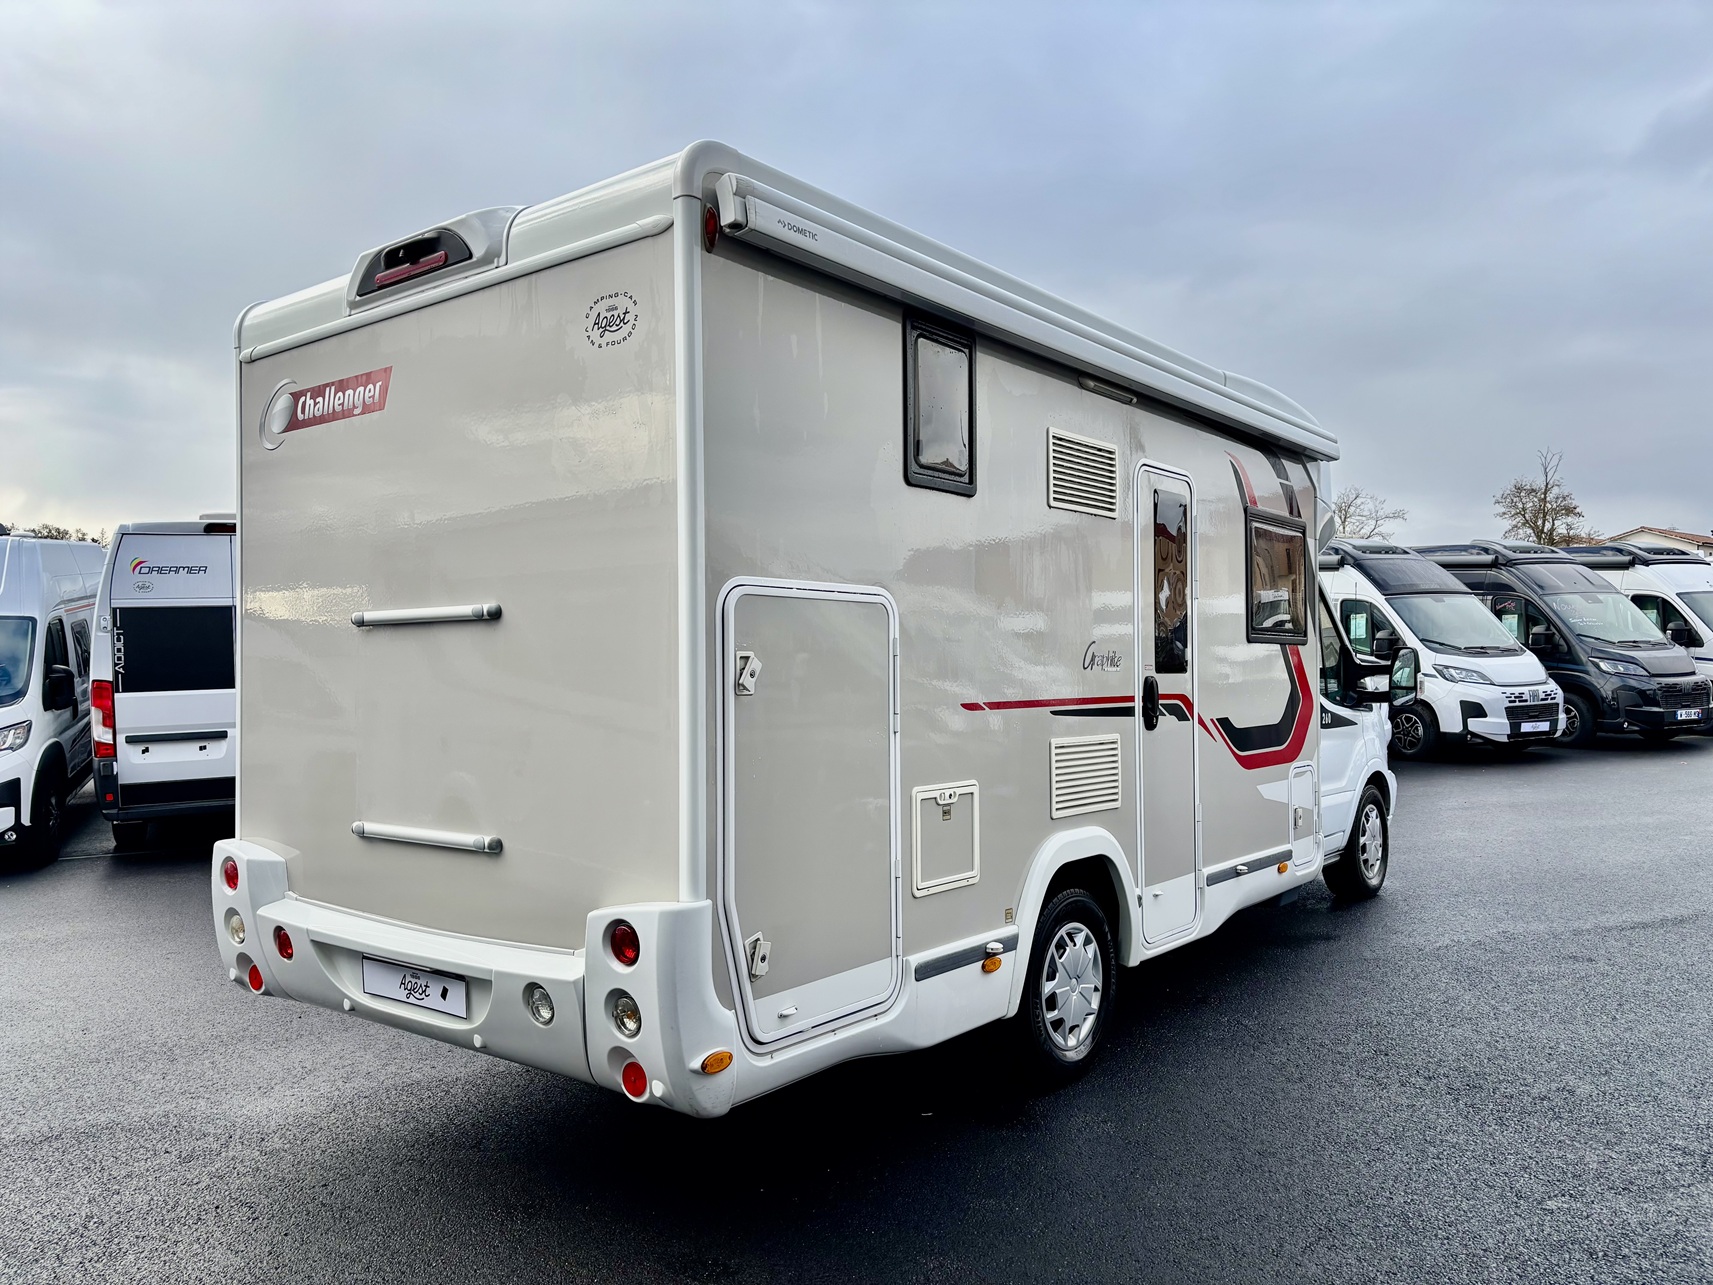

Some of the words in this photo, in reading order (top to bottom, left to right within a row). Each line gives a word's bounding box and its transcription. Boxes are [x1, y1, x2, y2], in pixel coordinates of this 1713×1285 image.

[787, 222, 818, 241] DOMETIC
[585, 291, 638, 319] CAMPING-CAR
[591, 307, 631, 338] Agest
[606, 314, 638, 347] FOURGON
[297, 381, 383, 421] Challenger
[138, 565, 208, 575] DREAMER
[114, 627, 125, 673] ADDICT
[1083, 640, 1122, 671] Graphite
[399, 974, 431, 1001] Agest
